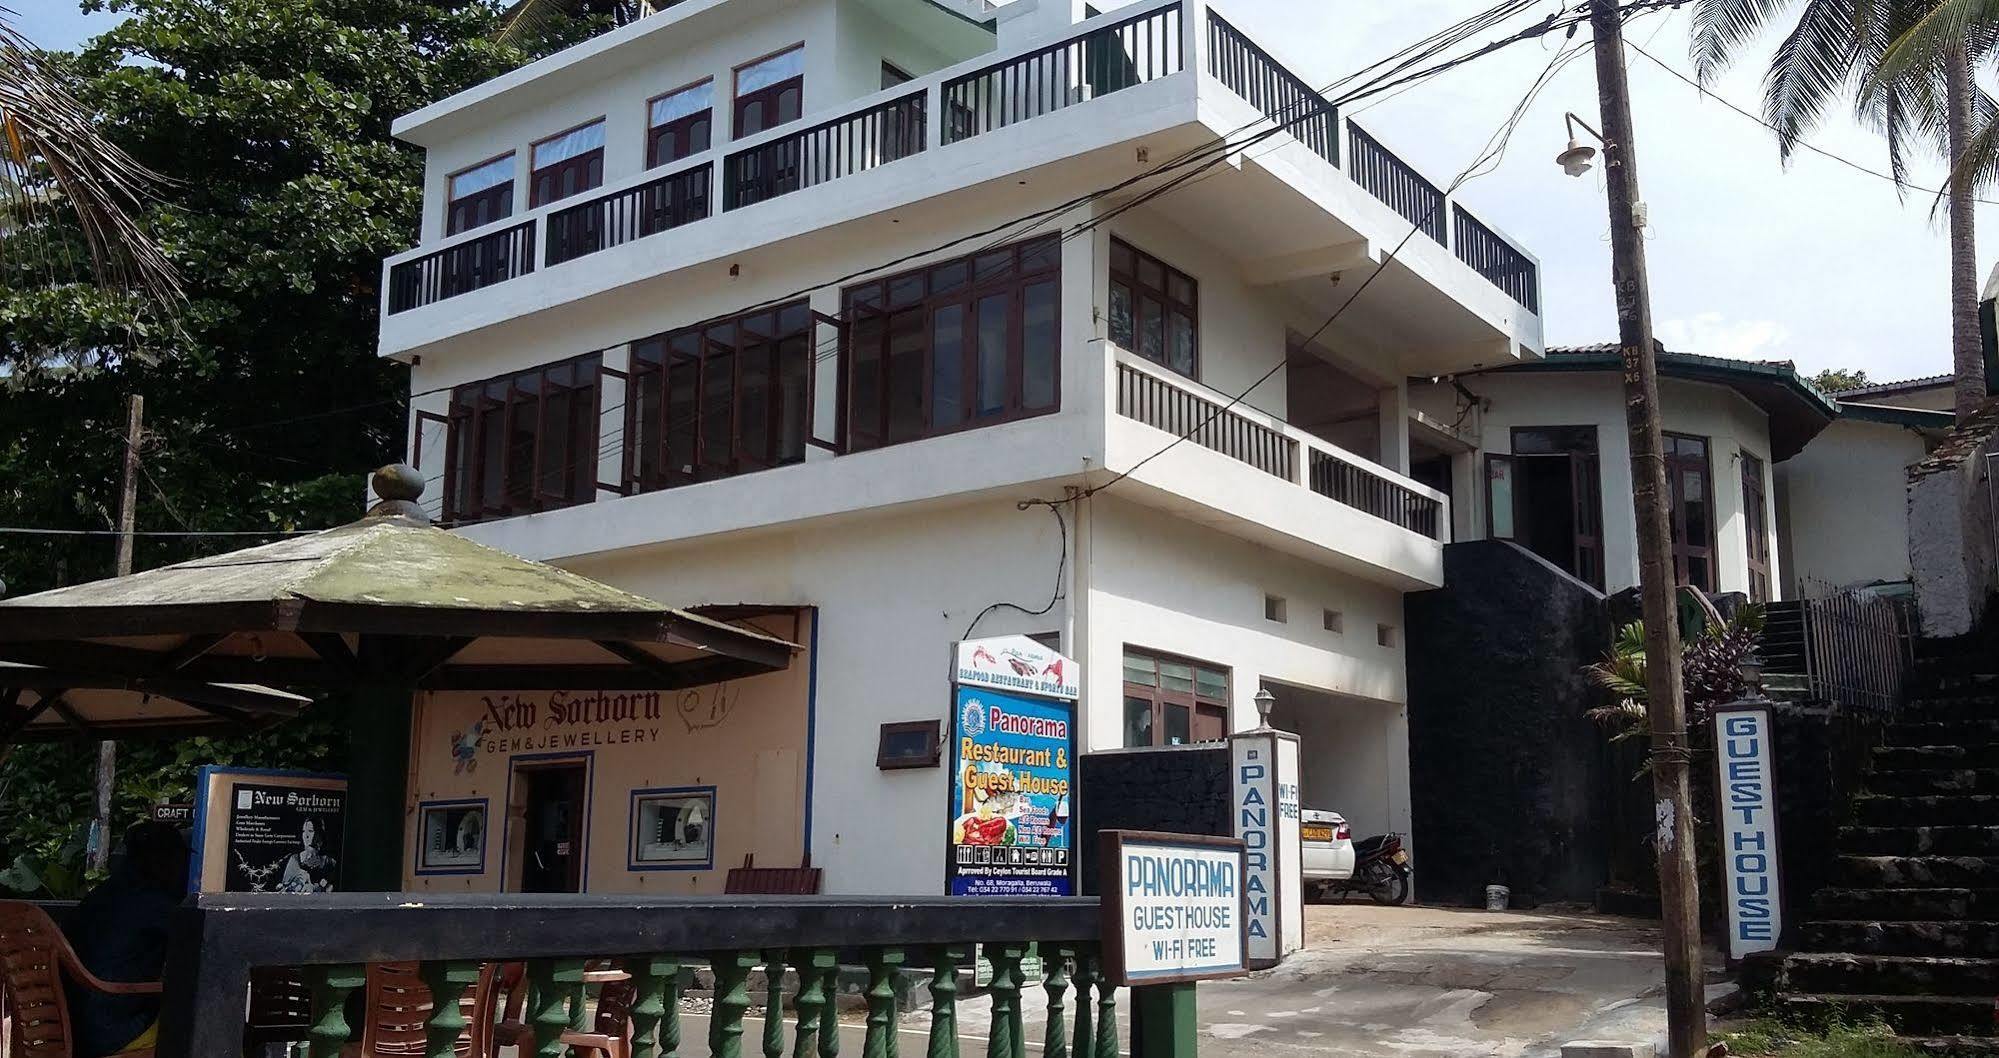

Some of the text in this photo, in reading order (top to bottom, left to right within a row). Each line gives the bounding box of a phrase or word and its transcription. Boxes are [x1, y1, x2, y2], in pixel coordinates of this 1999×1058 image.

[1623, 345, 1639, 357] KB
[1626, 358, 1639, 369] 37
[960, 668, 990, 683] SEAFOOD
[990, 673, 1033, 690] RESTAURANT
[1065, 686, 1077, 697] BAR
[481, 689, 661, 732] New Sorborn
[989, 705, 1067, 740] Panorama
[961, 736, 1068, 769] Restaurant &
[964, 764, 1069, 796] Guest House
[1726, 717, 1763, 825] GUEST
[254, 790, 341, 808] New Sorborn
[1279, 782, 1298, 800] WI-FI
[157, 807, 189, 819] CRAFT
[1279, 802, 1298, 819] FREE
[1241, 765, 1268, 938] PANORAMA
[985, 867, 992, 876] By
[993, 867, 1012, 877] Ceylon
[1012, 867, 1030, 876] Tourist
[1031, 867, 1046, 876] Board
[1047, 868, 1062, 876] Grade
[1062, 868, 1068, 876] A
[1128, 855, 1234, 898] PANORAMA
[1733, 831, 1772, 941] HOUSE
[1152, 937, 1216, 961] WI-FI FREE
